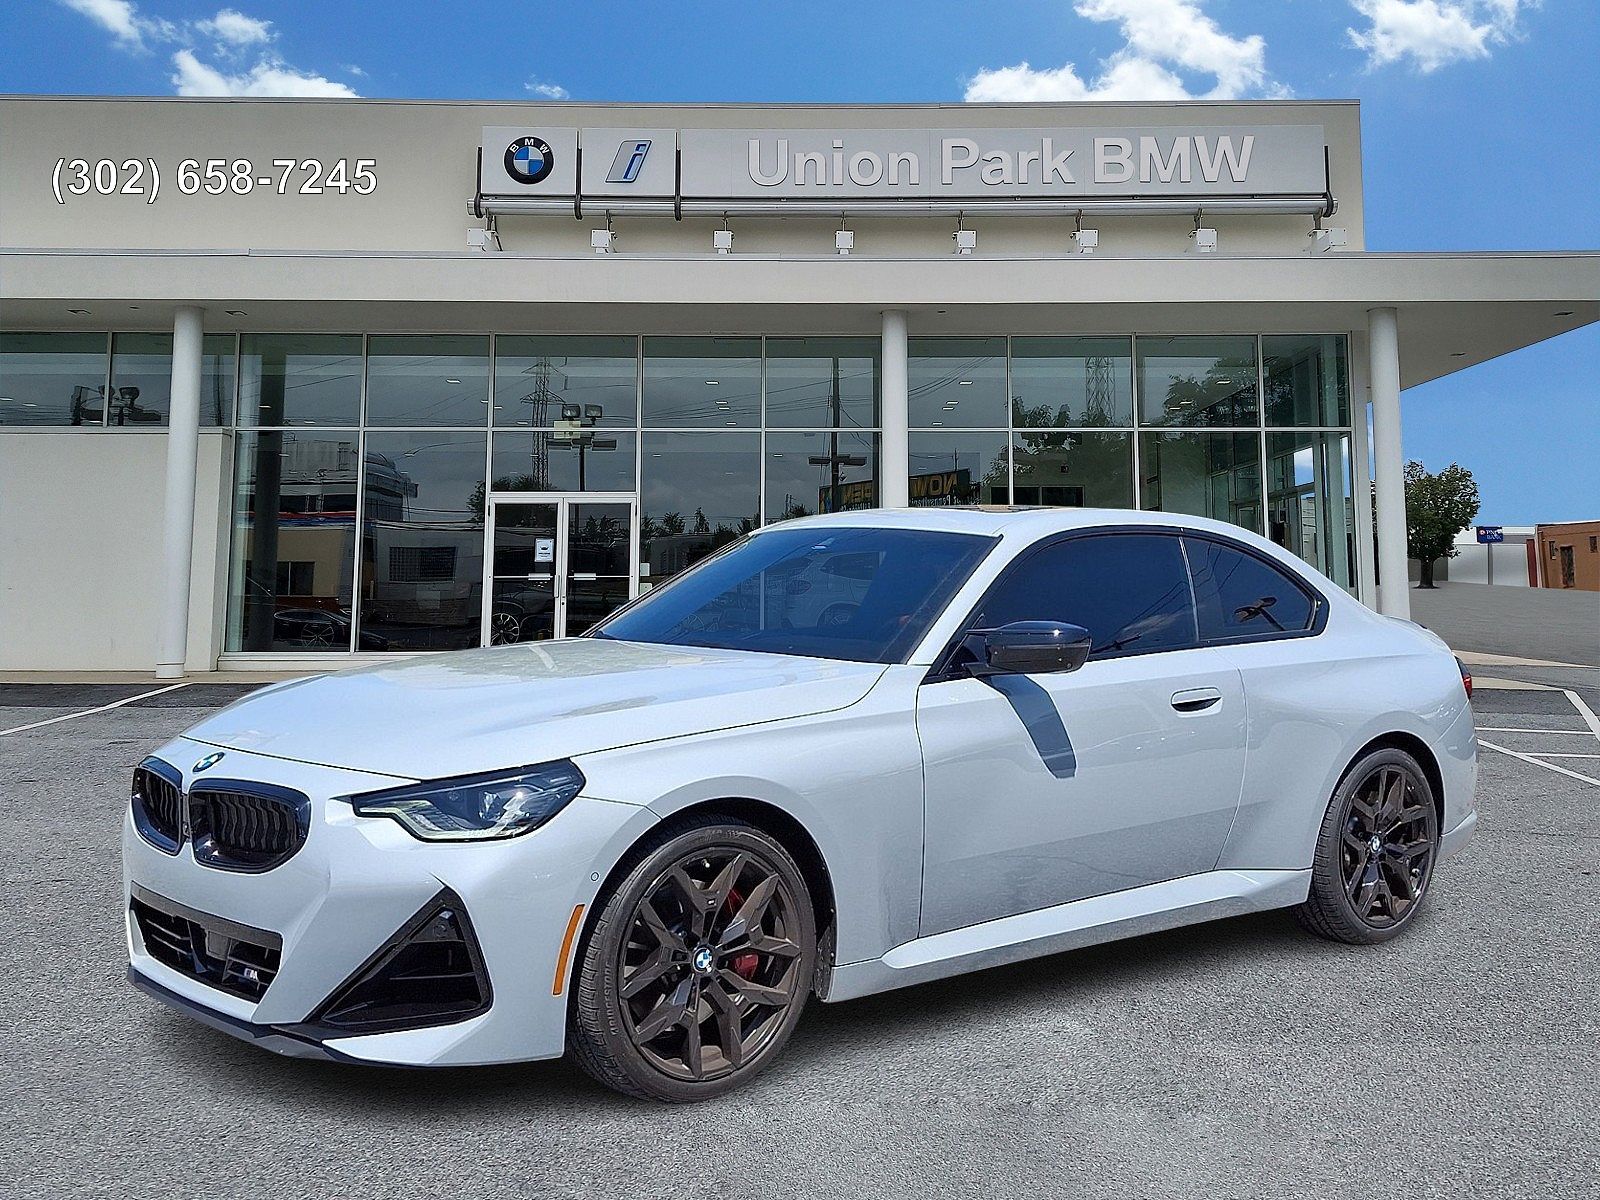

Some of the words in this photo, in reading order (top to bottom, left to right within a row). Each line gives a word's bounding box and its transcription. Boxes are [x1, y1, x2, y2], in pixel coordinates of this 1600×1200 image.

[509, 137, 550, 154] BMW
[747, 138, 920, 187] Union
[941, 137, 1076, 186] Park
[1093, 135, 1255, 184] BMW
